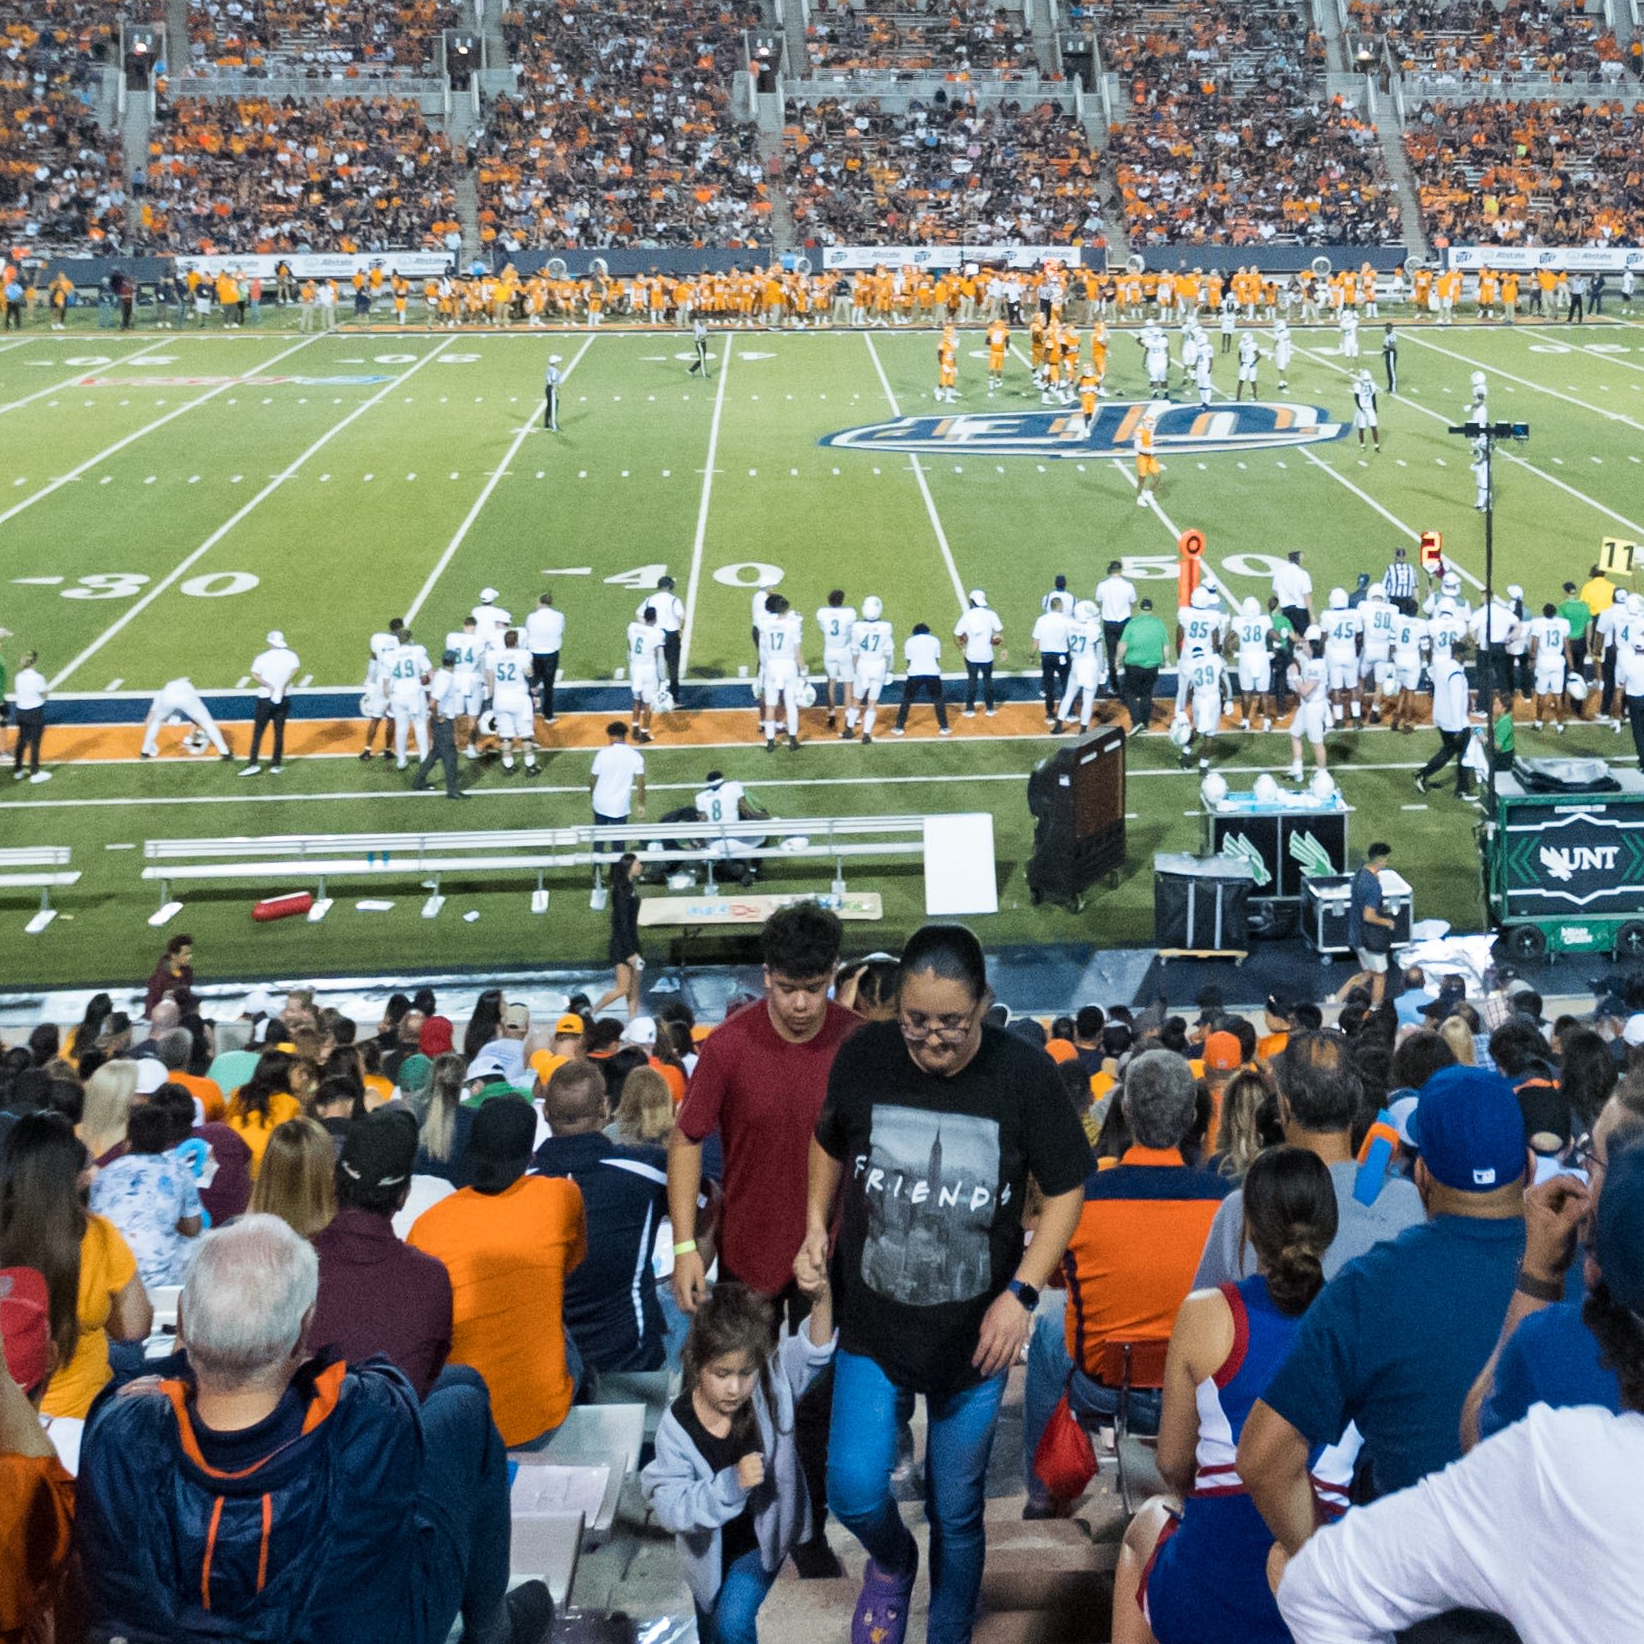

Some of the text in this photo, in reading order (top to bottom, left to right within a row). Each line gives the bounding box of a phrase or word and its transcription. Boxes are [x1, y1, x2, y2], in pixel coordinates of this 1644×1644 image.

[1421, 532, 1442, 562] 2
[1604, 541, 1636, 571] 11
[59, 571, 261, 600] 30
[829, 619, 840, 638] 3
[1333, 620, 1355, 640] 45
[1400, 627, 1411, 644] 6
[1545, 628, 1561, 648] 13
[633, 636, 644, 655] 6
[769, 631, 785, 652] 17
[859, 633, 881, 653] 47
[392, 659, 415, 679] 49
[496, 662, 516, 682] 52
[710, 798, 723, 822] 8
[1560, 845, 1621, 871] UNT
[854, 1154, 1013, 1212] FRIENDS
